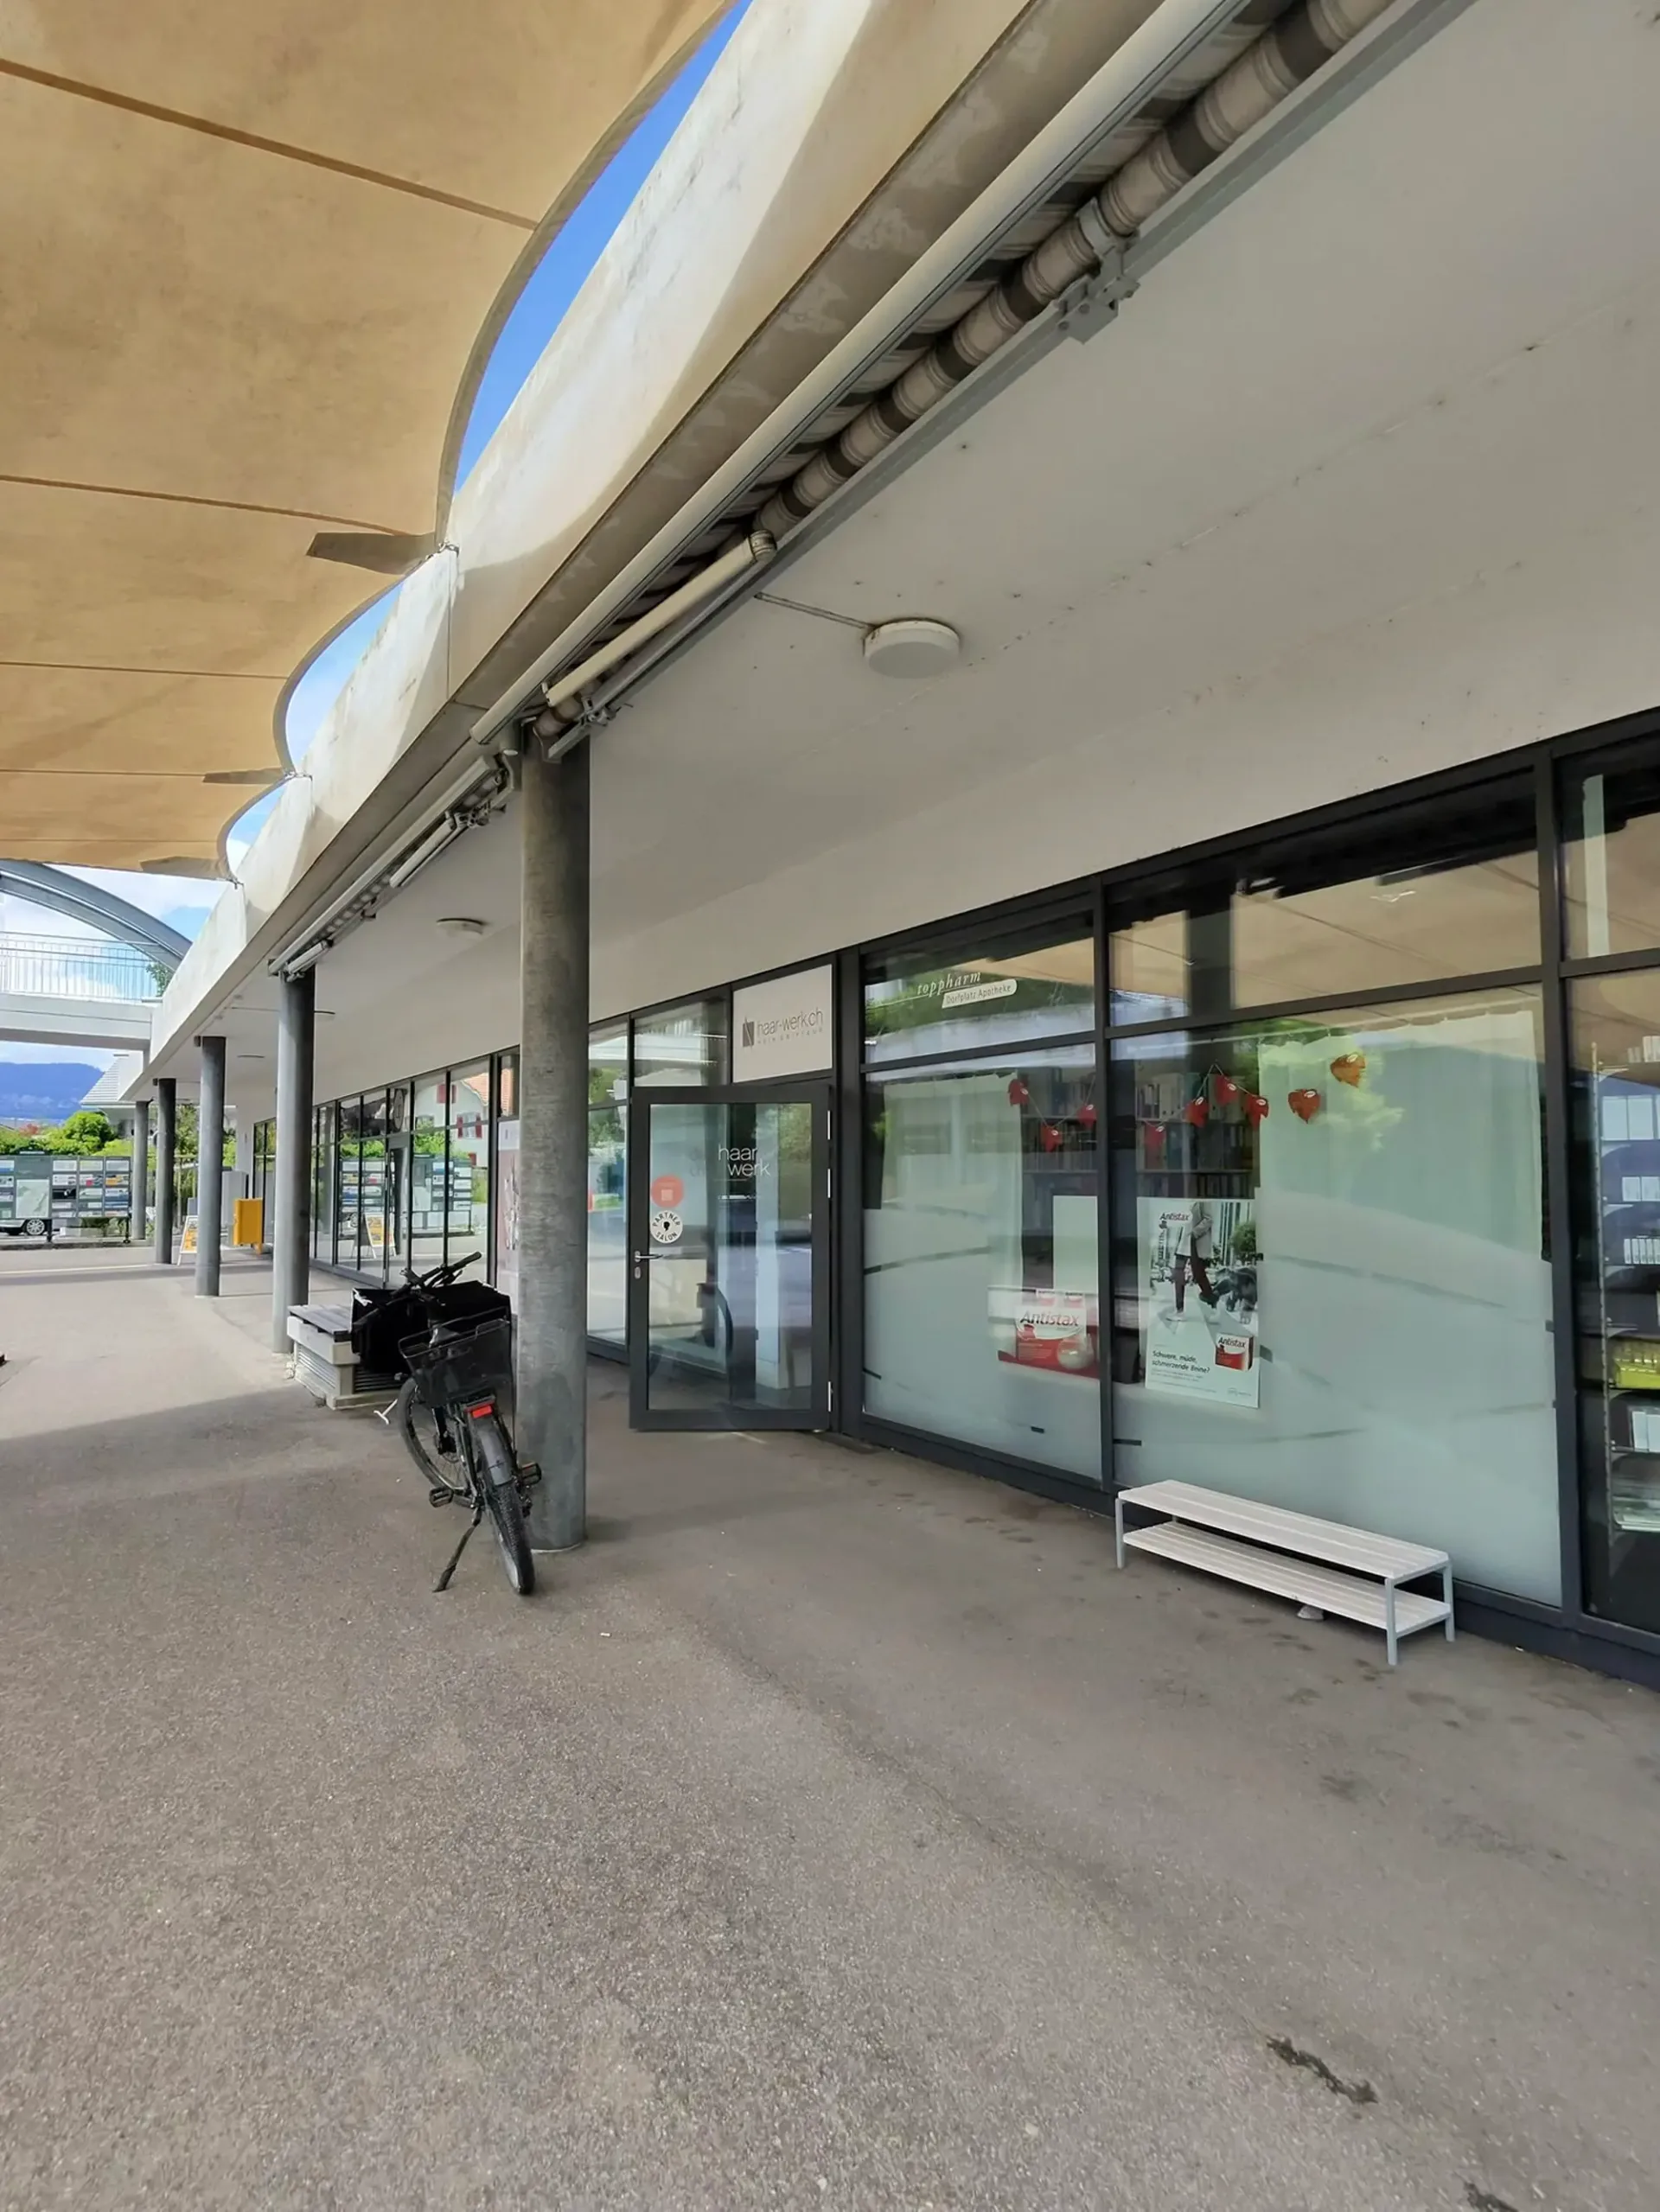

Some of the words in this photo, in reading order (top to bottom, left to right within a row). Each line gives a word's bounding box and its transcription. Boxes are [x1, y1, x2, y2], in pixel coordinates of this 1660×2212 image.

[916, 972, 981, 998] toppharm
[946, 991, 976, 1004] Dorfplatz
[978, 985, 1012, 999] Apotheke
[718, 1144, 758, 1161] haar
[727, 1157, 771, 1176] werk
[652, 1212, 680, 1227] PARTNER
[1159, 1212, 1190, 1221] Antistax
[655, 1231, 678, 1241] SALON
[1020, 1310, 1079, 1327] Antistax
[1218, 1336, 1246, 1348] Antistax
[1152, 1350, 1178, 1361] Schwere,
[1179, 1355, 1197, 1365] müde,
[1152, 1359, 1189, 1370] schmerzende
[1191, 1364, 1210, 1374] Beine?
